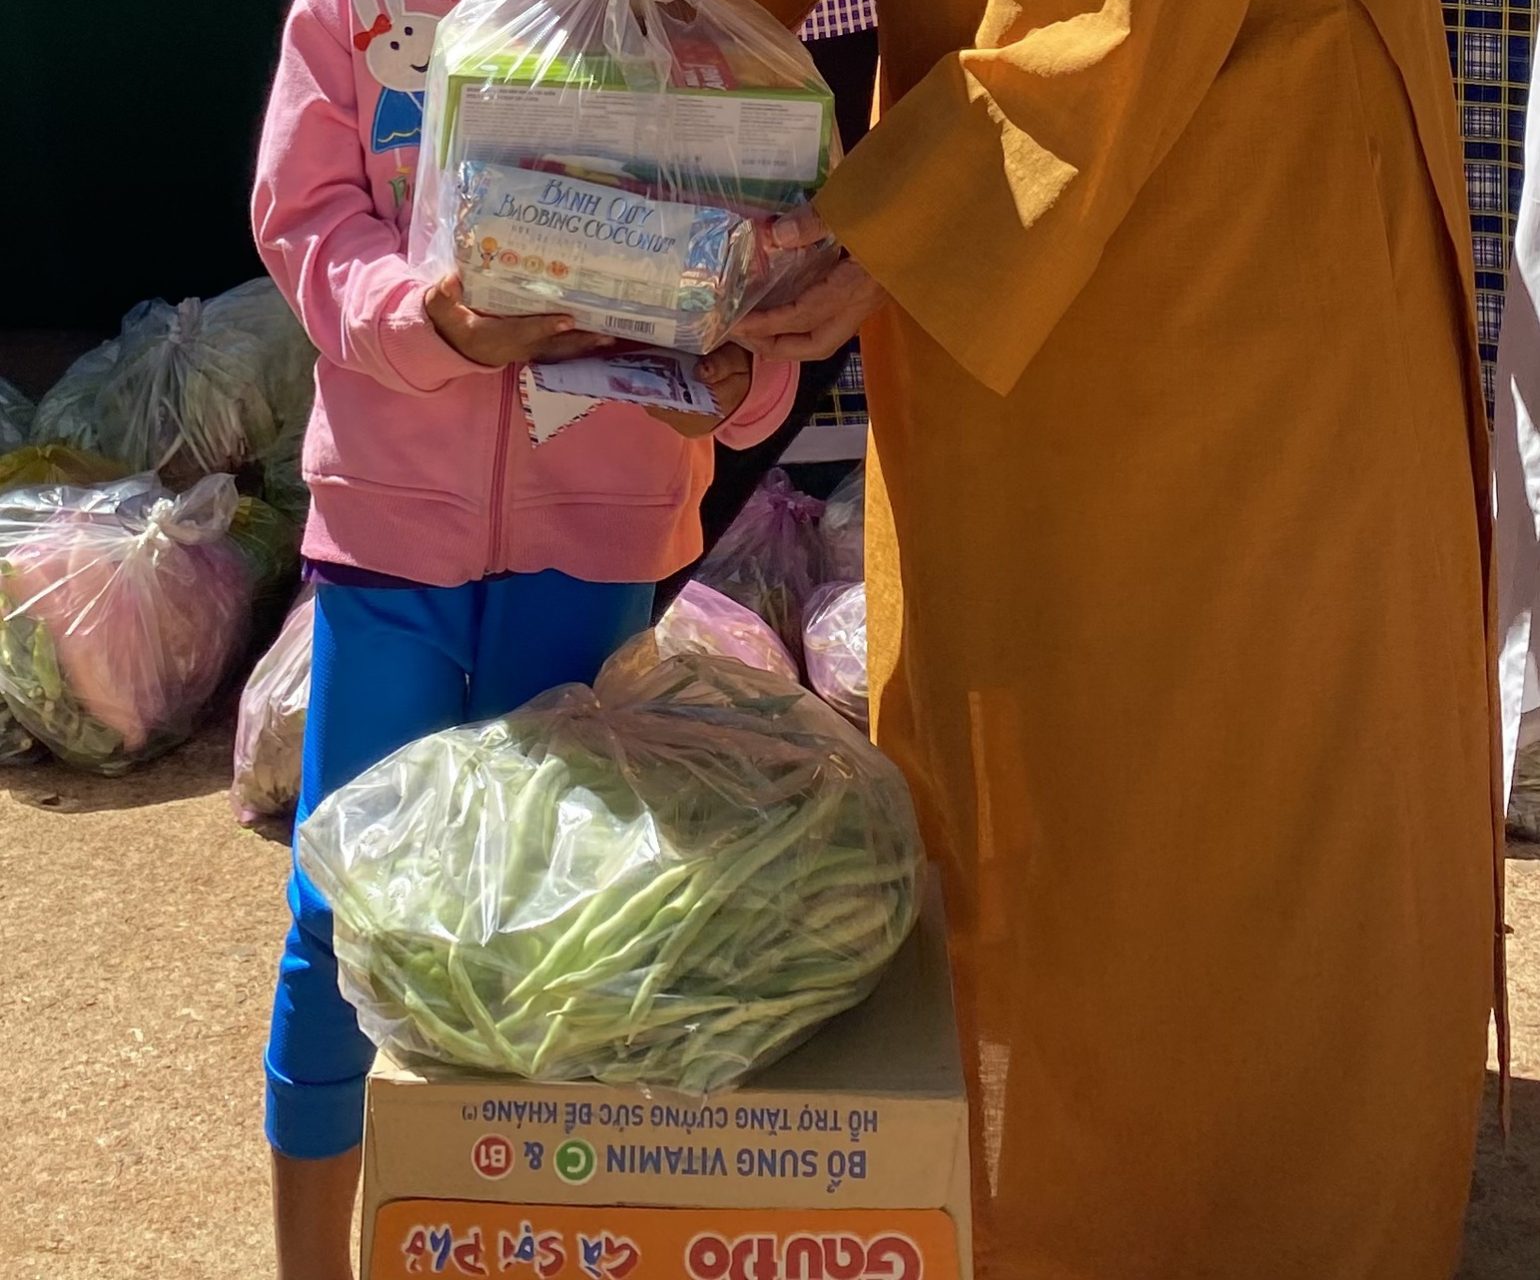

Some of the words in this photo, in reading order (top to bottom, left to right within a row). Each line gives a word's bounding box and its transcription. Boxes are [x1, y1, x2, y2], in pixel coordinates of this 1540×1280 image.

[494, 193, 581, 233] BAOBING
[482, 1100, 558, 1129] KHÁNG
[600, 1103, 645, 1132] SỨC
[651, 1105, 728, 1135] CƯỜNG
[735, 1107, 792, 1136] TĂNG
[797, 1104, 842, 1131] TRỢ
[848, 1109, 878, 1142] HỖ
[479, 1144, 507, 1169] B1
[523, 1141, 544, 1170] &
[566, 1146, 587, 1173] C
[606, 1144, 728, 1176] VITAMIN
[737, 1148, 819, 1178] SUNG
[826, 1149, 867, 1193] BỔ
[405, 1227, 488, 1275] Phở
[501, 1224, 565, 1278] Sợi
[579, 1235, 641, 1279] Gà
